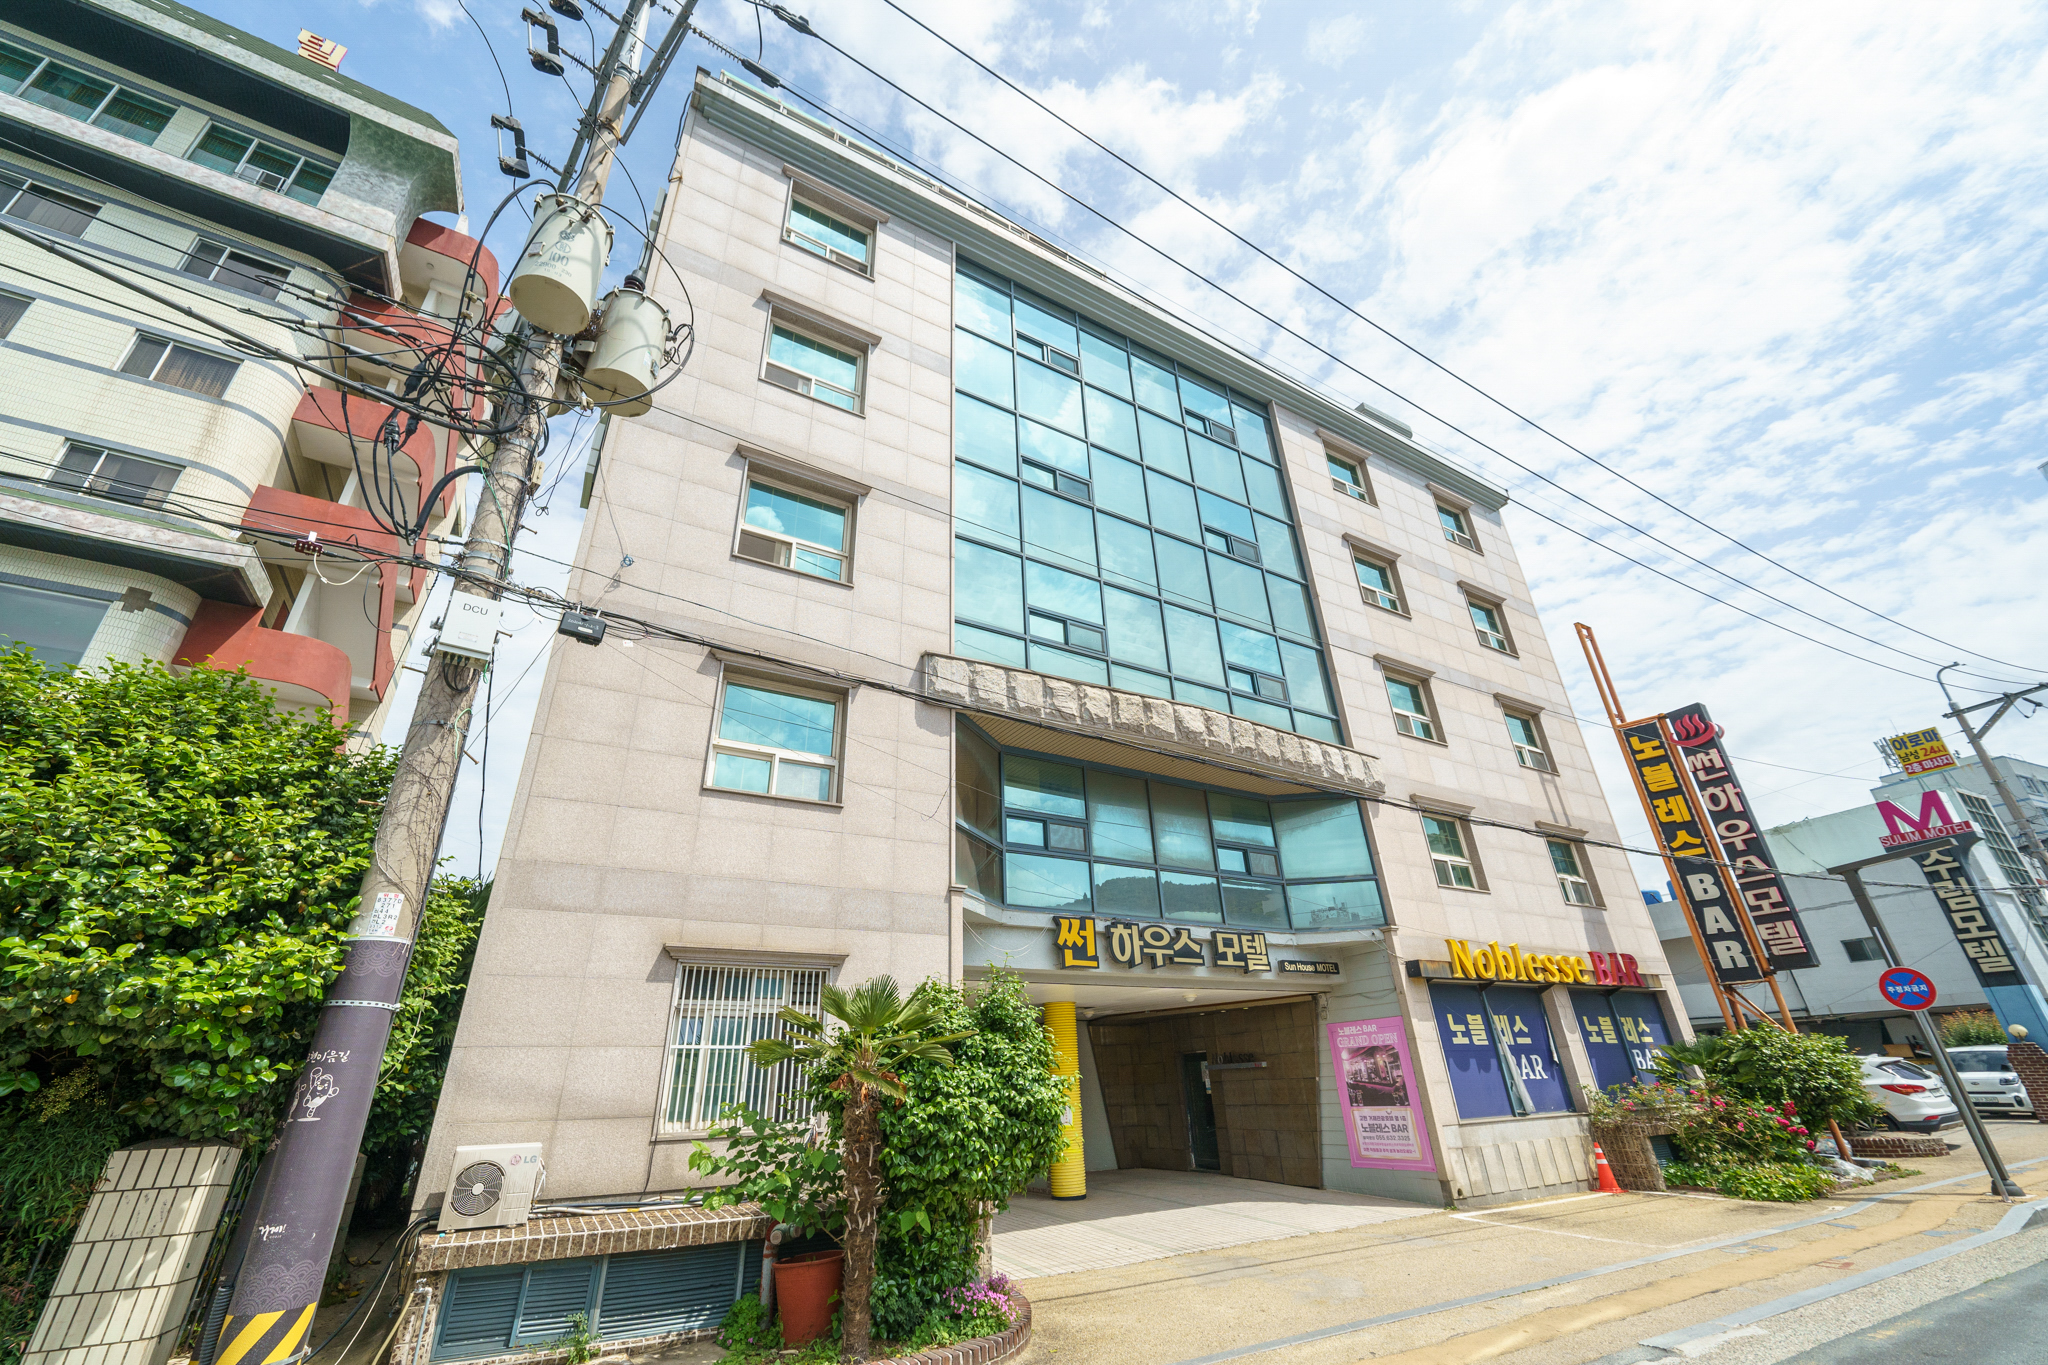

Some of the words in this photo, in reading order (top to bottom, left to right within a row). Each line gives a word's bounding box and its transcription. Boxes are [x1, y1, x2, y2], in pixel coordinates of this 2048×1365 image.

[549, 251, 569, 267] 100
[463, 602, 489, 616] DCU
[1892, 729, 1940, 751] 아로마
[1899, 751, 1920, 763] 남성
[1920, 745, 1947, 757] 24시
[1905, 763, 1923, 773] 2층
[1922, 755, 1954, 769] 마사지
[1880, 832, 1922, 848] SULIM
[1925, 822, 1974, 839] MOTEL
[1629, 736, 1706, 857] 노블레스
[1686, 873, 1749, 969] BAR
[1921, 850, 2016, 974] 수림모텔
[1057, 918, 1098, 968] 썬
[1110, 923, 1204, 966] 하우스
[1217, 932, 1270, 972] 모텔
[1284, 962, 1297, 971] Sun
[1297, 962, 1315, 972] House
[1316, 963, 1337, 973] MOTEL
[1445, 938, 1591, 984] Noblesse
[1588, 951, 1646, 987] BAR
[1887, 984, 1928, 994] 주정차금지
[1338, 1025, 1362, 1036] 노블레스
[1362, 1024, 1378, 1033] BAR
[1582, 1015, 1654, 1044] 노블레스
[1337, 1034, 1369, 1048] GRAND
[1371, 1032, 1399, 1046] OPEN
[1361, 1122, 1390, 1133] 노블레스
[1391, 1124, 1409, 1133] BAR
[523, 1155, 537, 1164] LG
